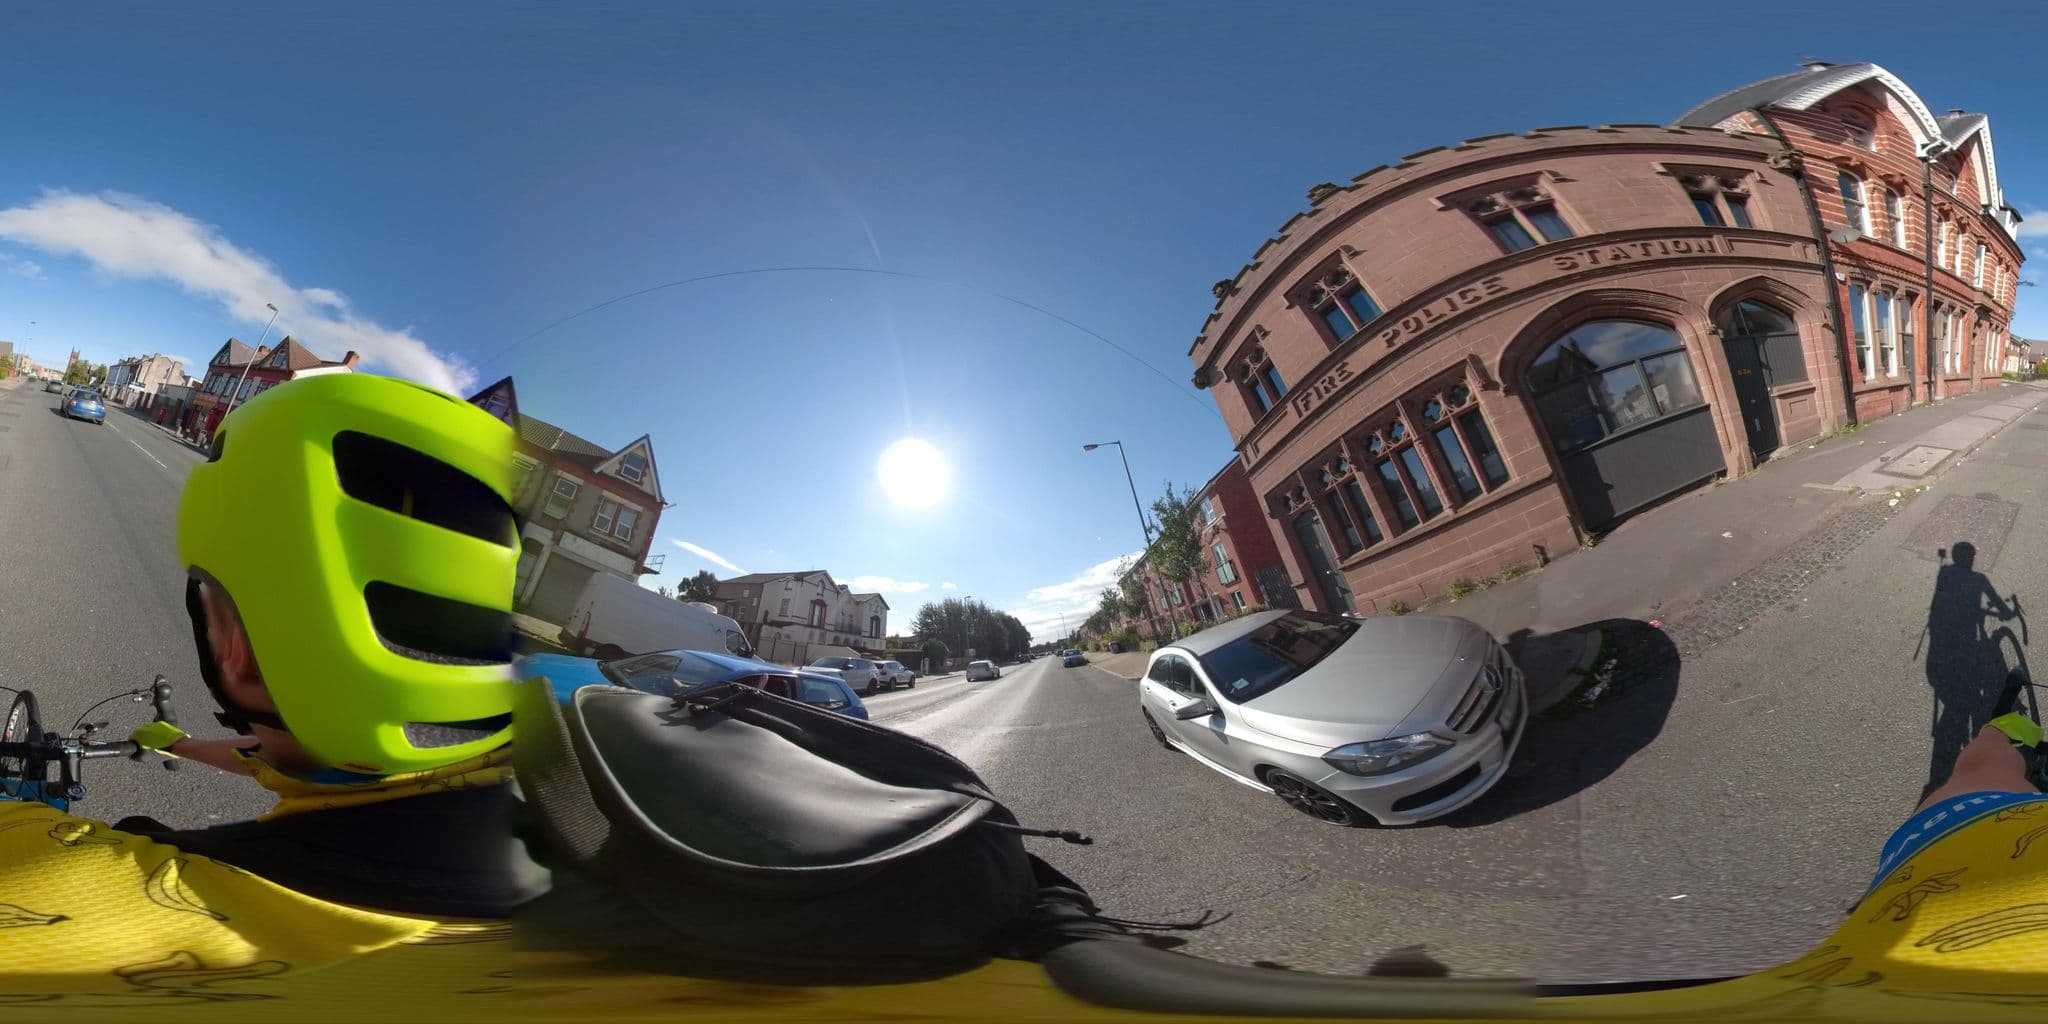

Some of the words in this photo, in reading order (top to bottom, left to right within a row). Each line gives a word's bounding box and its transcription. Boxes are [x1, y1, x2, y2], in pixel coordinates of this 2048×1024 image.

[1299, 361, 1355, 412] FIRE
[1380, 275, 1509, 348] POLICE
[1553, 239, 1717, 271] STATION
